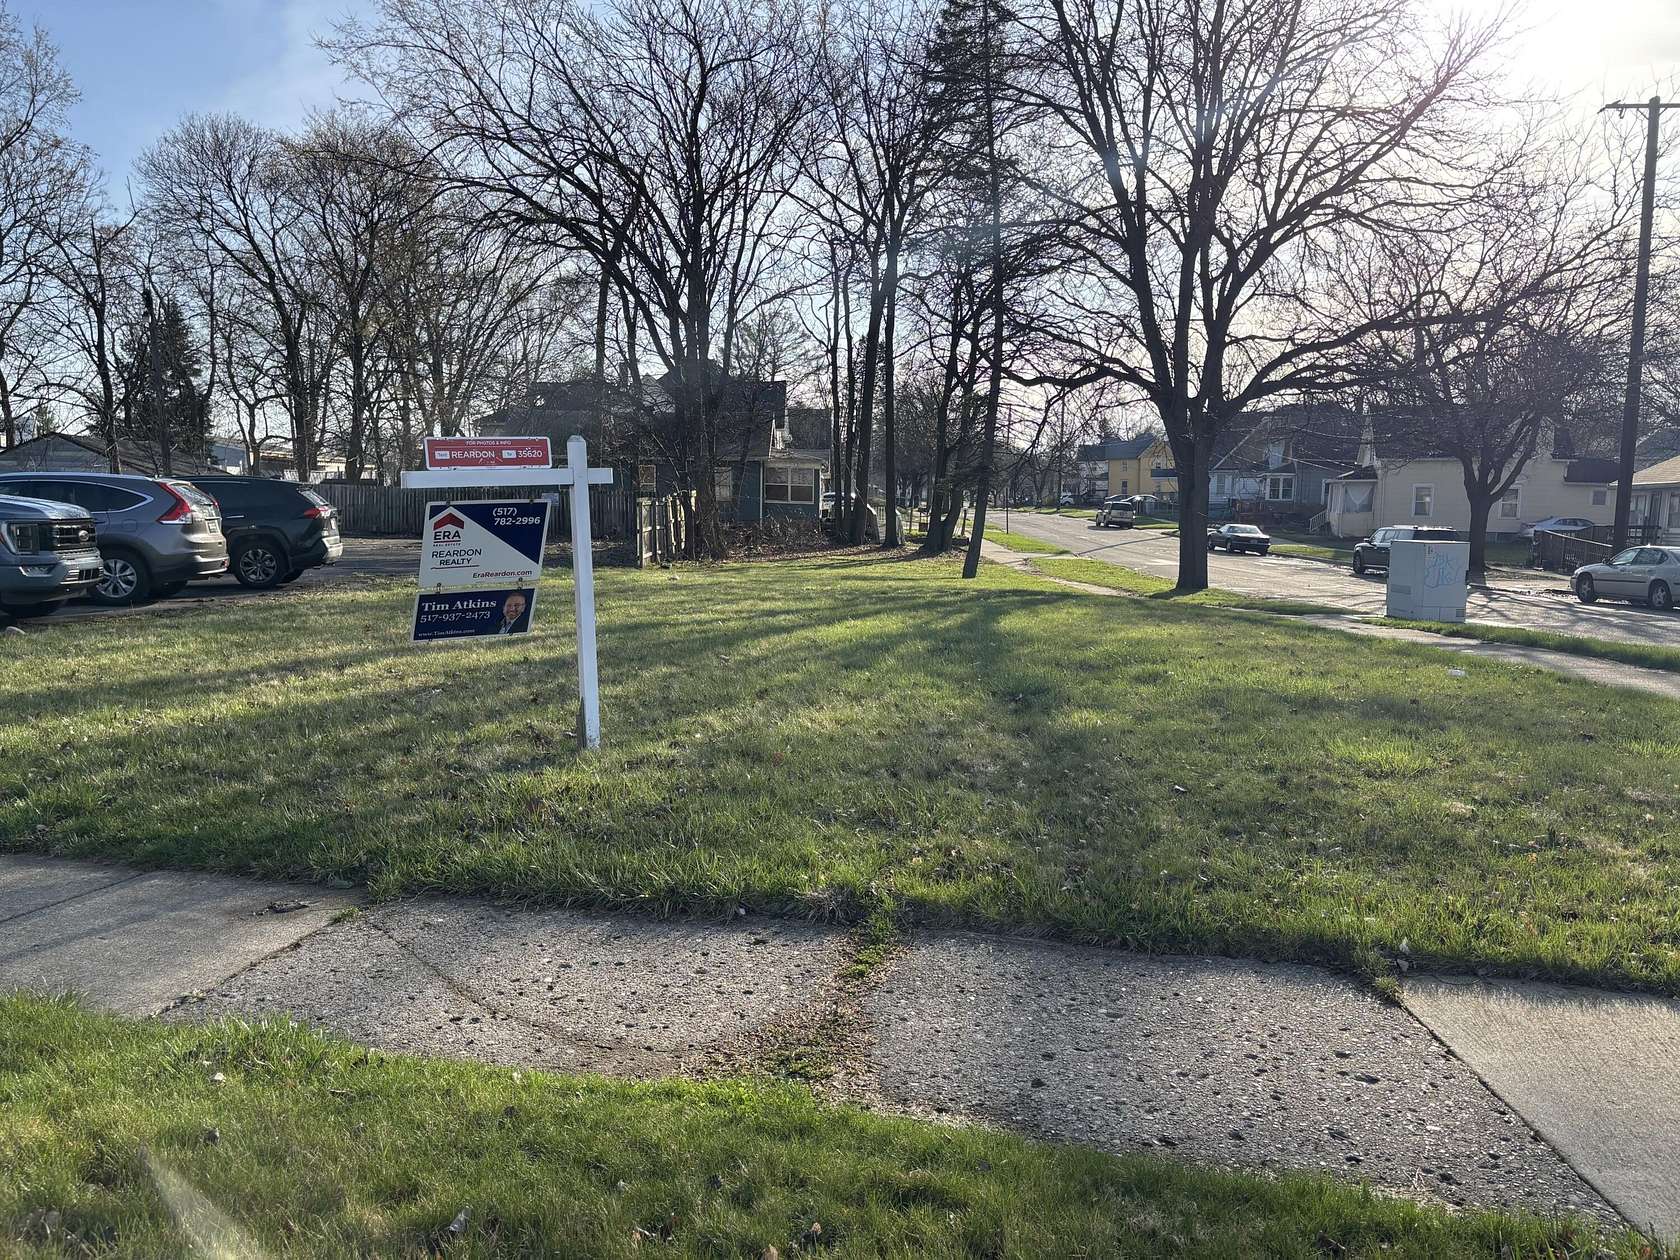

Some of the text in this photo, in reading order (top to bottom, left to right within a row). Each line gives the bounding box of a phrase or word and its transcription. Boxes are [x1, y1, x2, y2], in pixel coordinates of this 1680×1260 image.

[451, 450, 495, 459] REARDON
[518, 450, 543, 458] 35620
[492, 507, 518, 517] (517)
[494, 516, 541, 526] 782-2996
[433, 530, 461, 541] ERA
[431, 548, 482, 559] REARDON
[439, 558, 473, 567] REALTY
[472, 570, 533, 579] EraReardon.com
[422, 599, 497, 612] Tim Atkins
[420, 611, 491, 623] 517-937-2473
